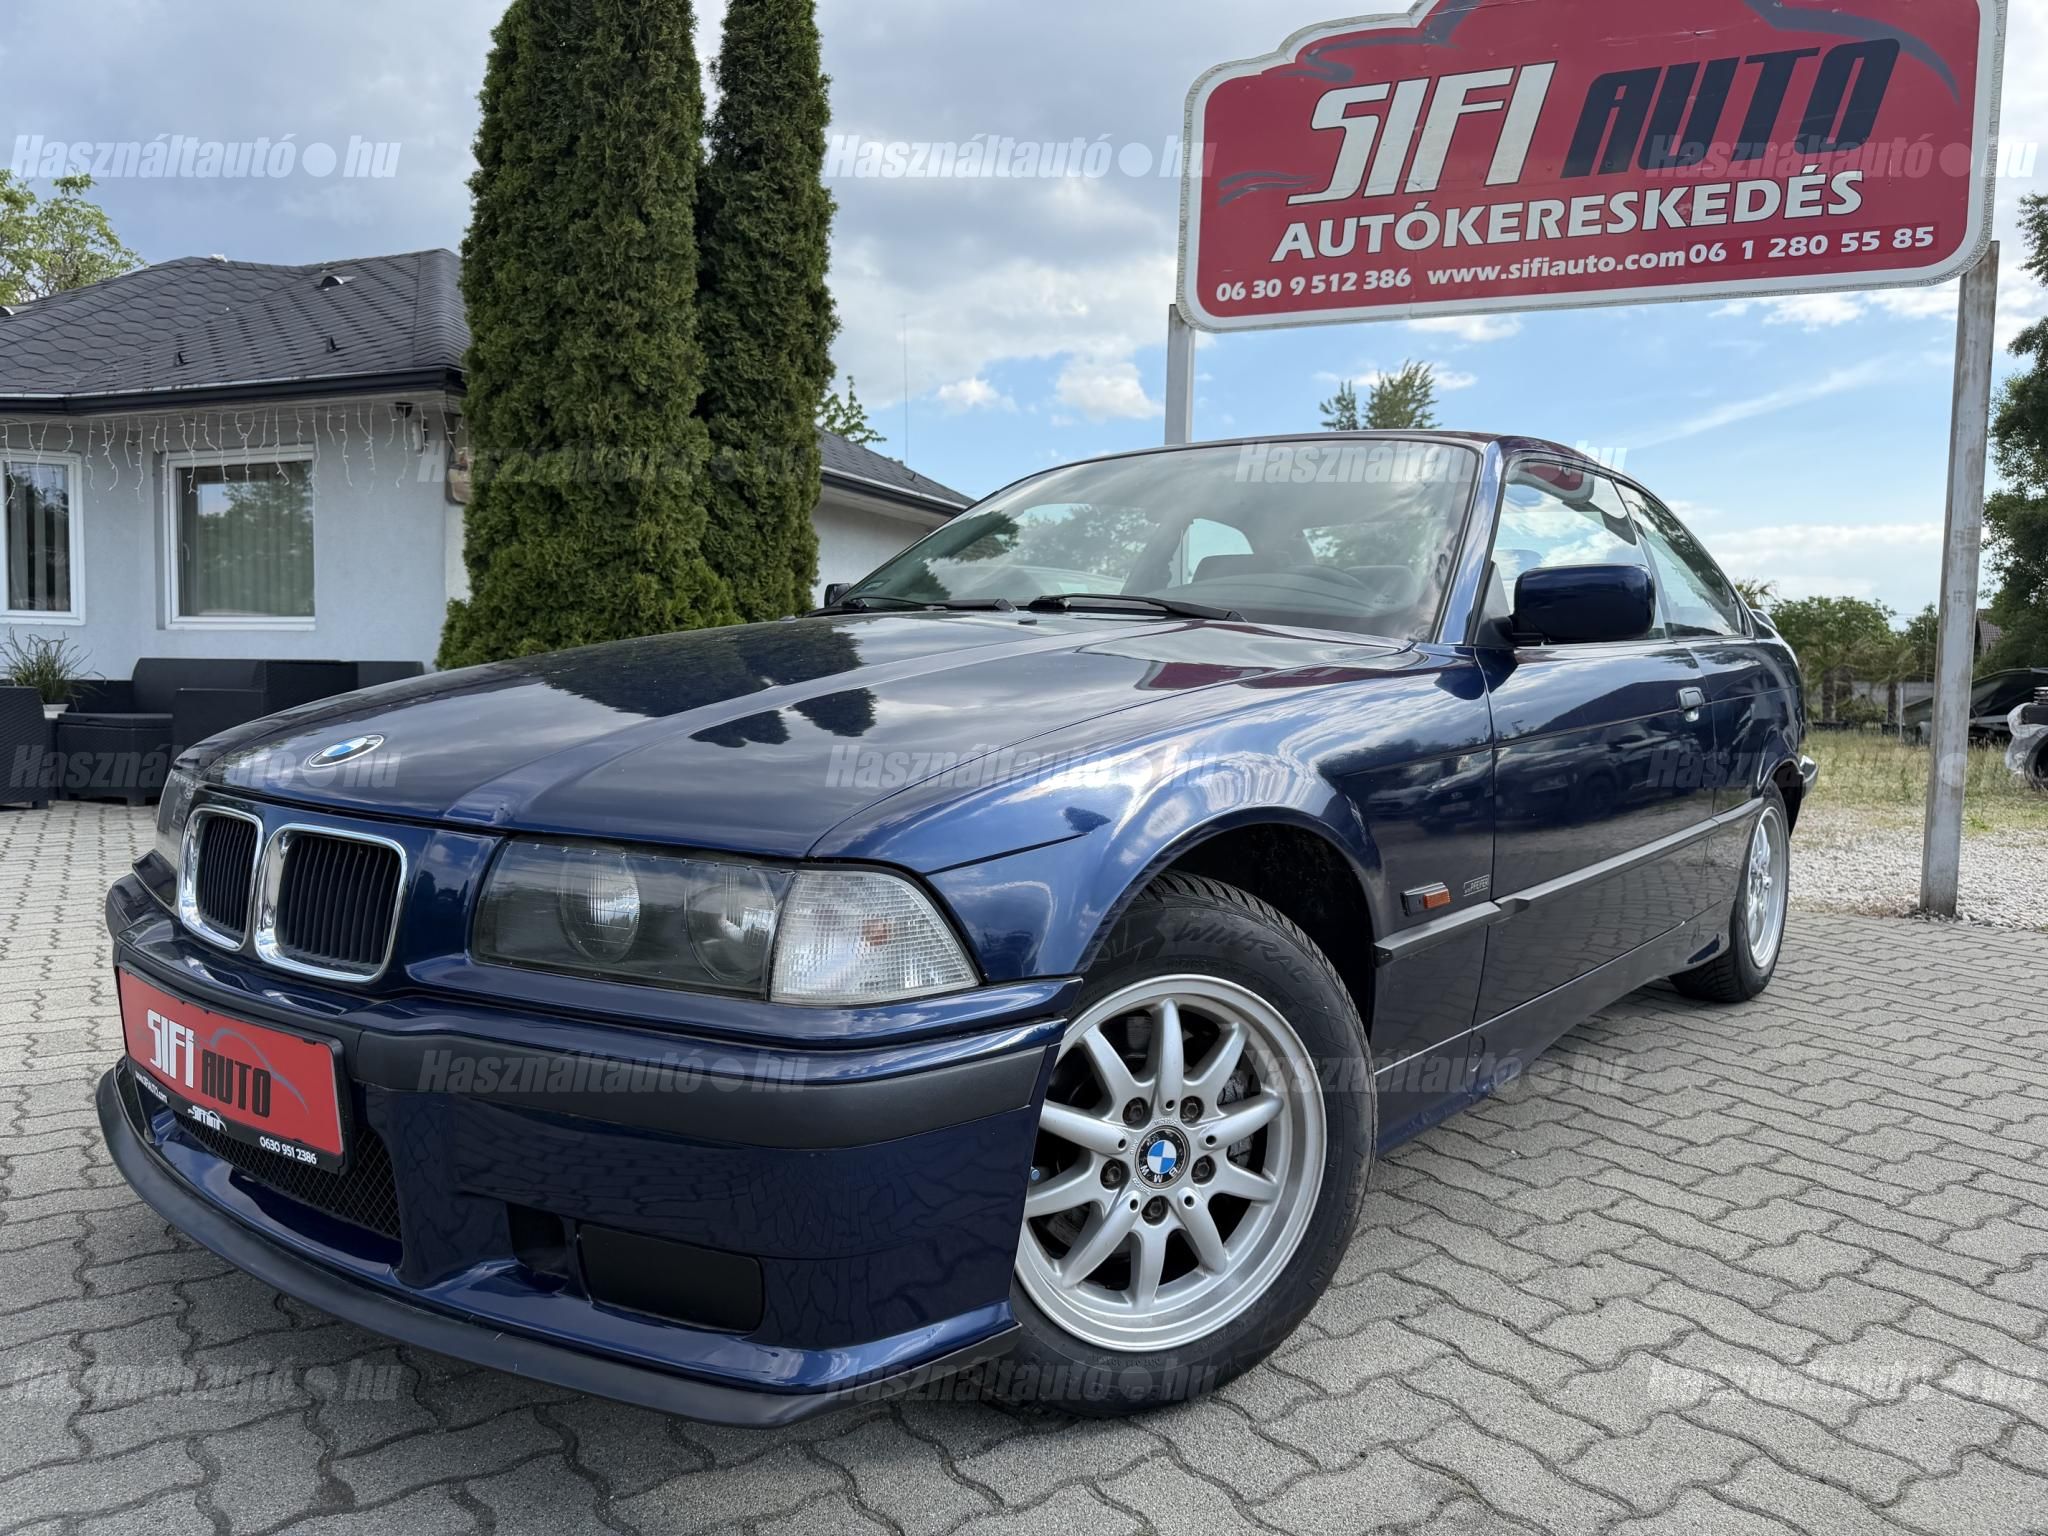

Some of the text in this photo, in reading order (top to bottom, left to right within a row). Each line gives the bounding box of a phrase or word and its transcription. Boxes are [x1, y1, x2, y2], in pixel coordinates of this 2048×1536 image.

[1287, 38, 1900, 206] SIFI AUTO
[1270, 165, 1864, 263] AUTÓKERESKEDÉS
[1689, 226, 1934, 264] 06 1 280 55 85
[1216, 267, 1411, 302] 06 30 9 512 386
[1427, 249, 1685, 286] www.sifiauto.com
[201, 1049, 272, 1118] AUTO
[260, 1136, 317, 1165] 0630 951 2386
